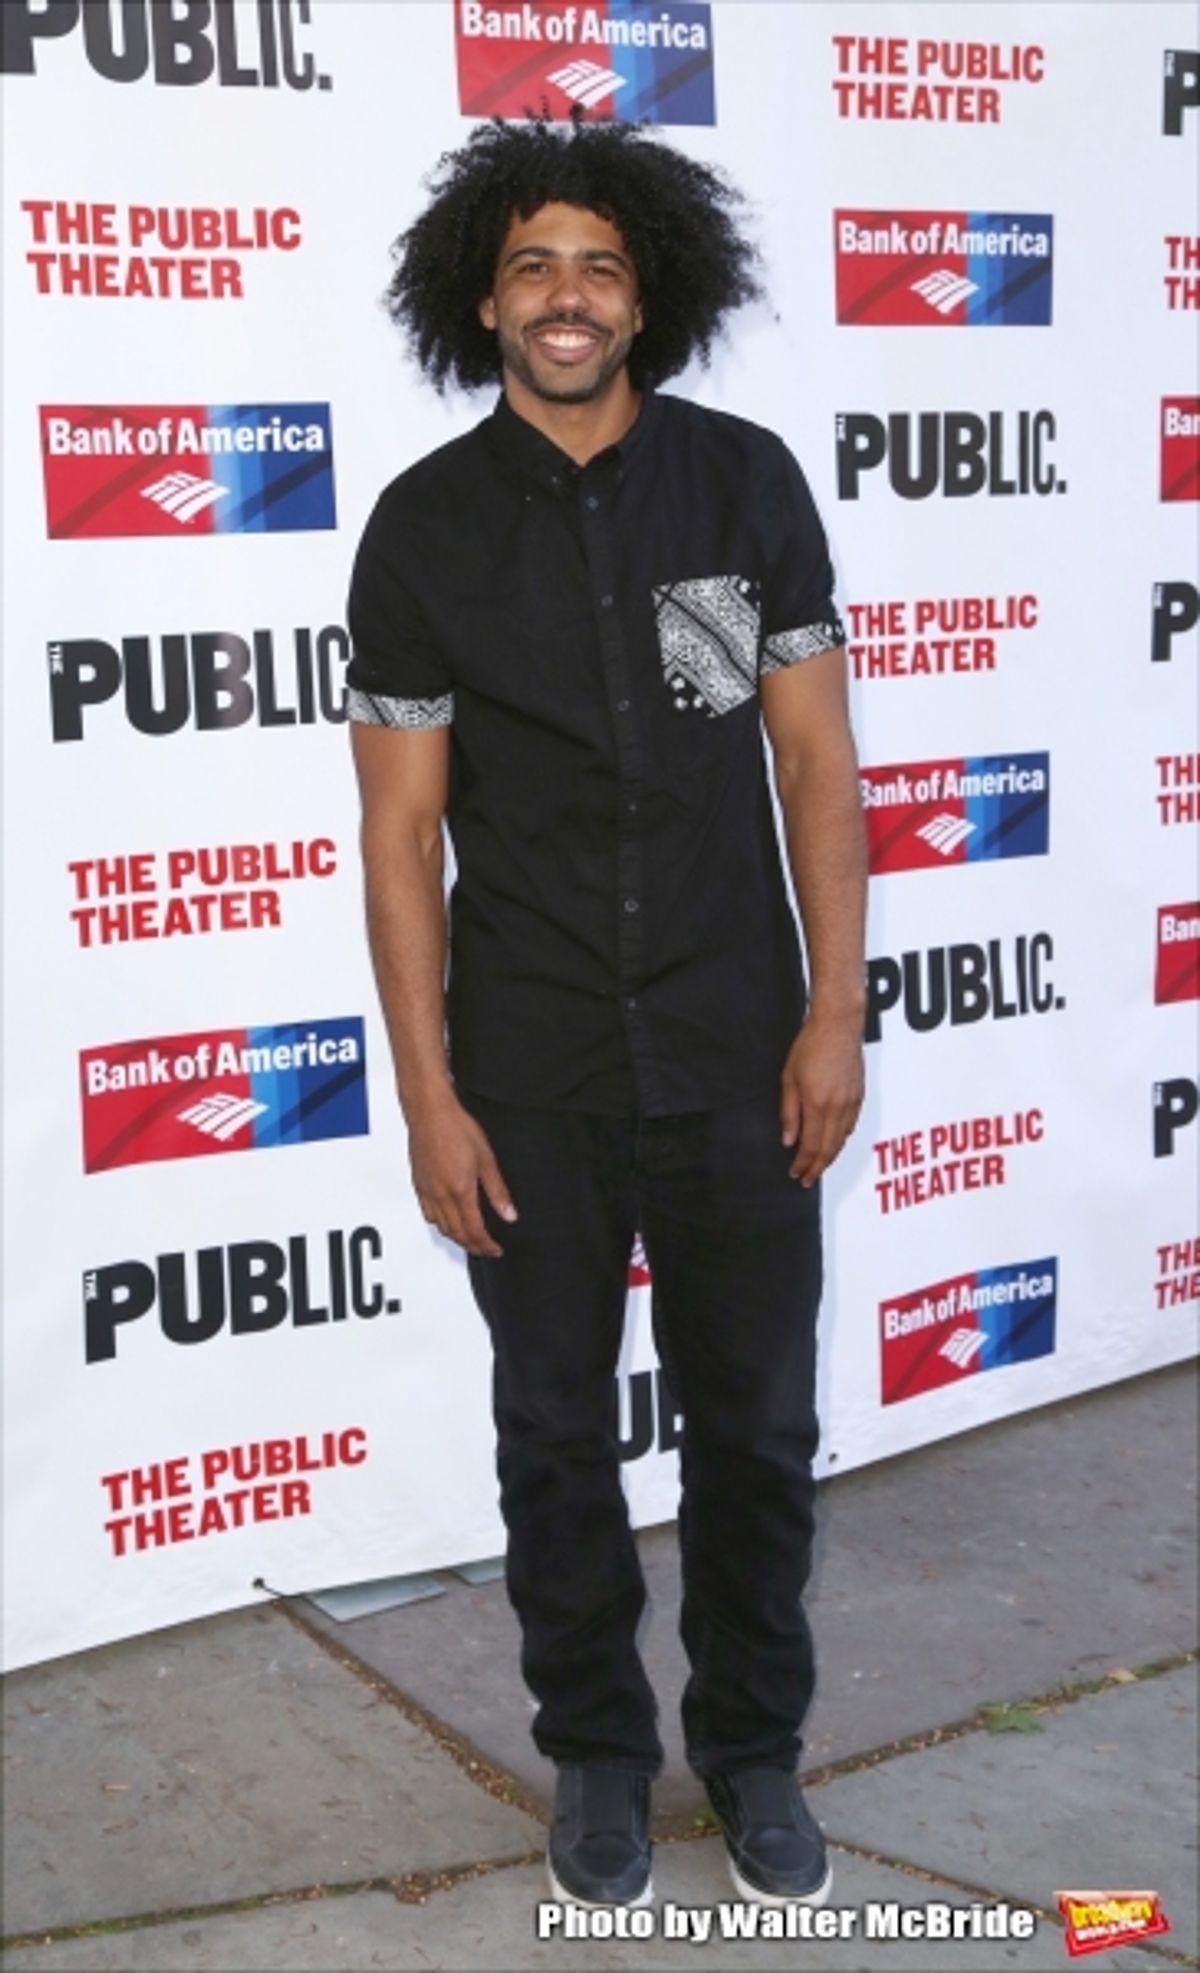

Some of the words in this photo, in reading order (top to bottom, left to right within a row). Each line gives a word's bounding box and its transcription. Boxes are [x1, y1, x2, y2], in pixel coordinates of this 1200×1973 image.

[462, 2, 543, 42] Bank
[545, 7, 577, 43] of
[581, 9, 707, 49] America
[832, 36, 908, 75] THE
[916, 40, 1044, 83] PUBLIC
[832, 81, 1000, 123] THEATER
[20, 201, 118, 246] THE
[129, 206, 302, 250] PUBLIC
[838, 220, 909, 254] Bank
[911, 222, 940, 254] of
[942, 223, 1049, 256] America
[26, 252, 243, 299] THEATER
[49, 417, 134, 455] Bank
[138, 418, 173, 455] of
[177, 417, 324, 455] America
[836, 409, 1066, 500] PUBLIC.
[847, 602, 905, 638] THE
[915, 595, 1038, 634] PUBLIC
[848, 637, 995, 679] THEATER
[914, 772, 942, 802] of
[943, 764, 1044, 798] America
[68, 853, 156, 900] THE
[168, 838, 337, 889] PUBLIC
[70, 889, 281, 948] THEATER
[86, 1051, 171, 1096] Bank
[174, 1044, 213, 1081] of
[214, 1032, 358, 1076] America
[873, 1131, 924, 1175] THE
[930, 1108, 1043, 1159] PUBLIC
[875, 1155, 1005, 1214] THEATER
[82, 1224, 401, 1364] PUBLIC.
[884, 1298, 936, 1340] Bank
[937, 1289, 958, 1321] of
[959, 1272, 1053, 1315] America
[101, 1457, 191, 1512] THE
[202, 1427, 367, 1490] PUBLIC
[105, 1480, 311, 1557] THEATER
